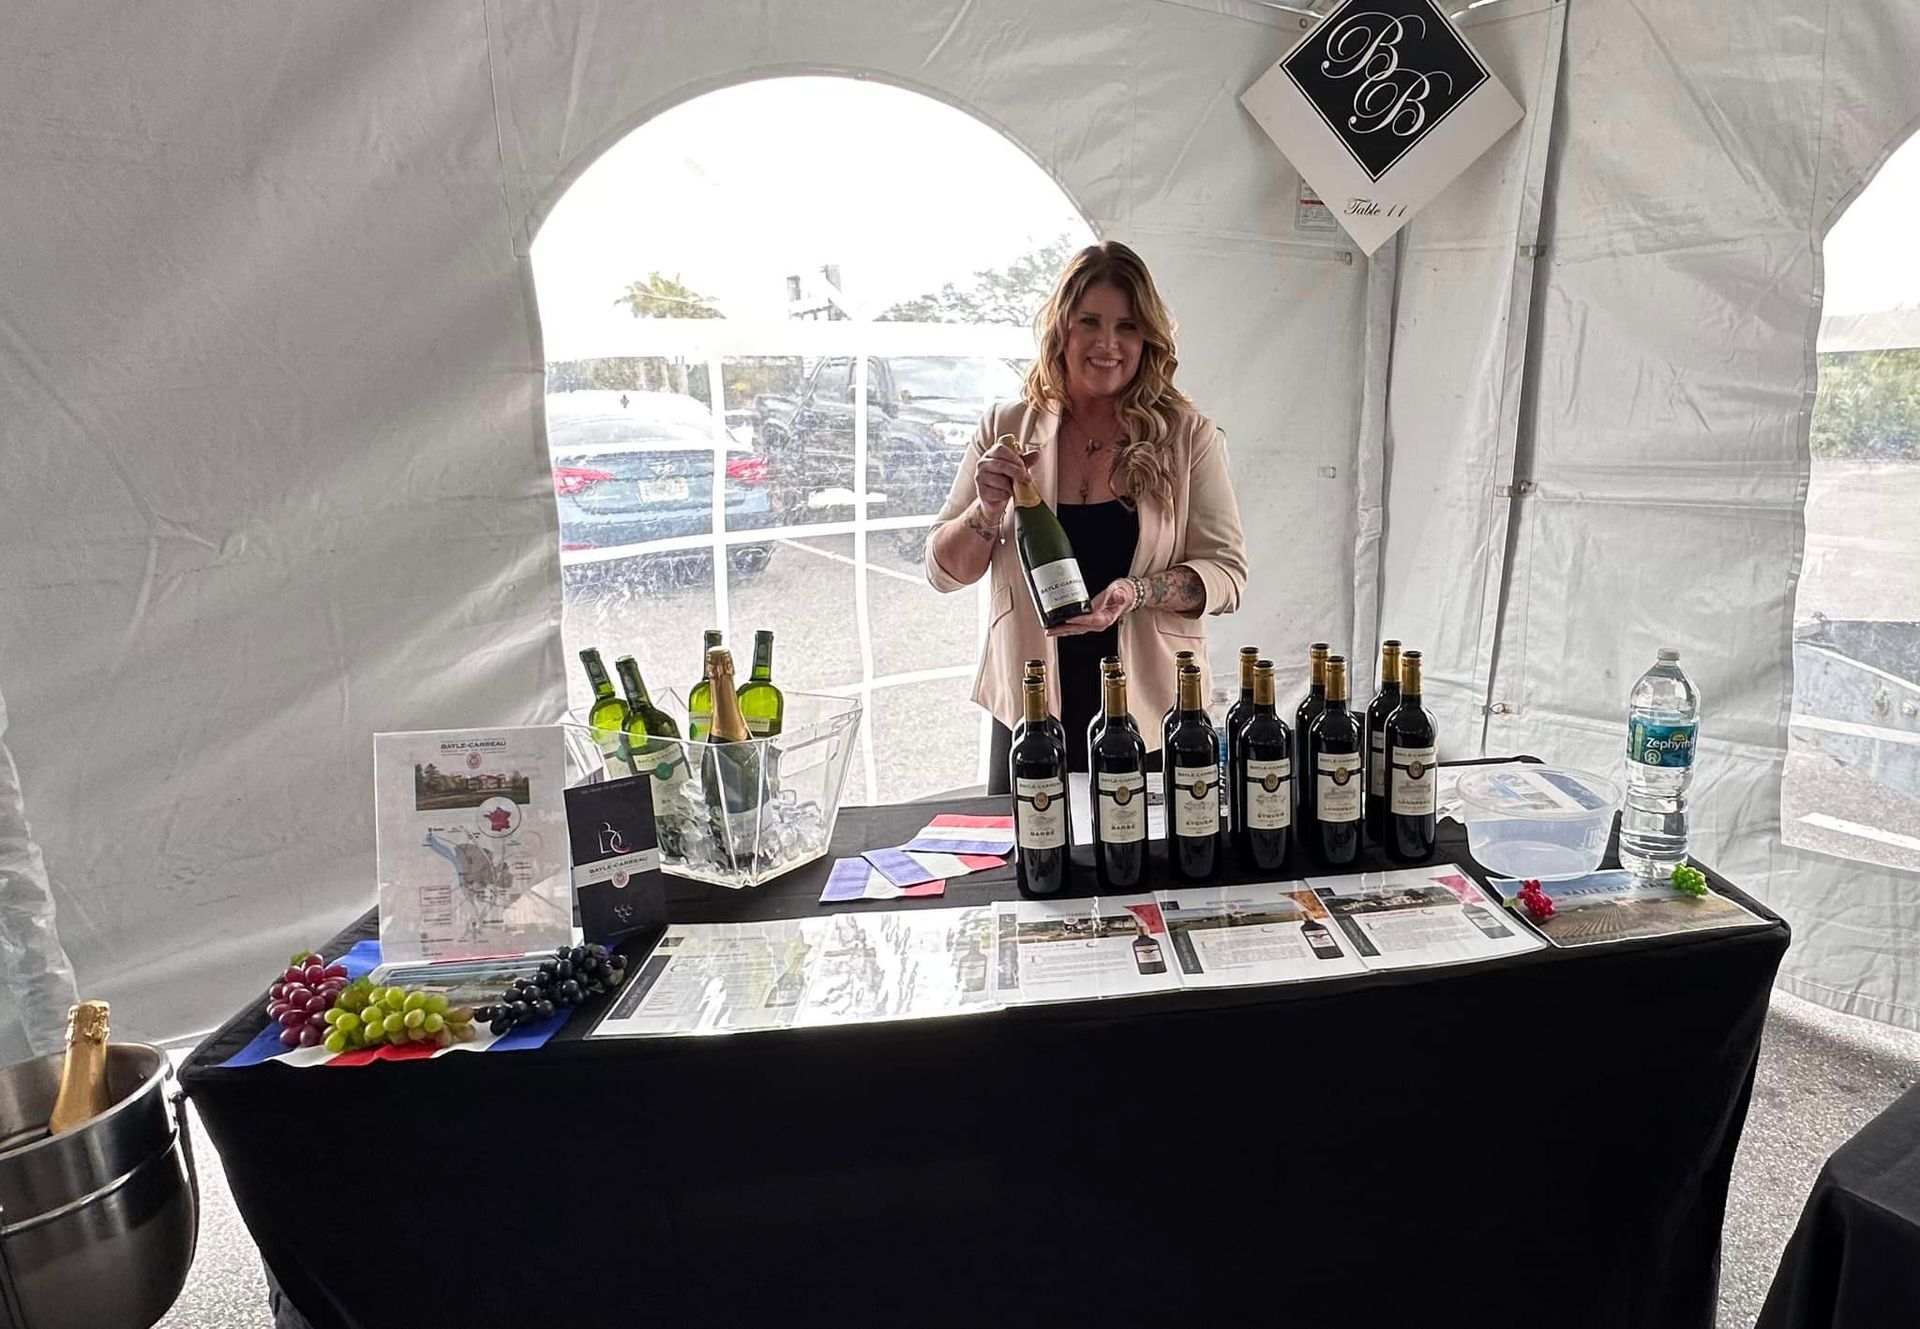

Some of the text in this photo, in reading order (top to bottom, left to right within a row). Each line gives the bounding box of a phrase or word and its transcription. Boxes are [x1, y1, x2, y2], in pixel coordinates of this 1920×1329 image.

[1344, 196, 1381, 216] Table
[1386, 203, 1409, 218] 11
[1562, 882, 1665, 896] BAYLE-CAREAU
